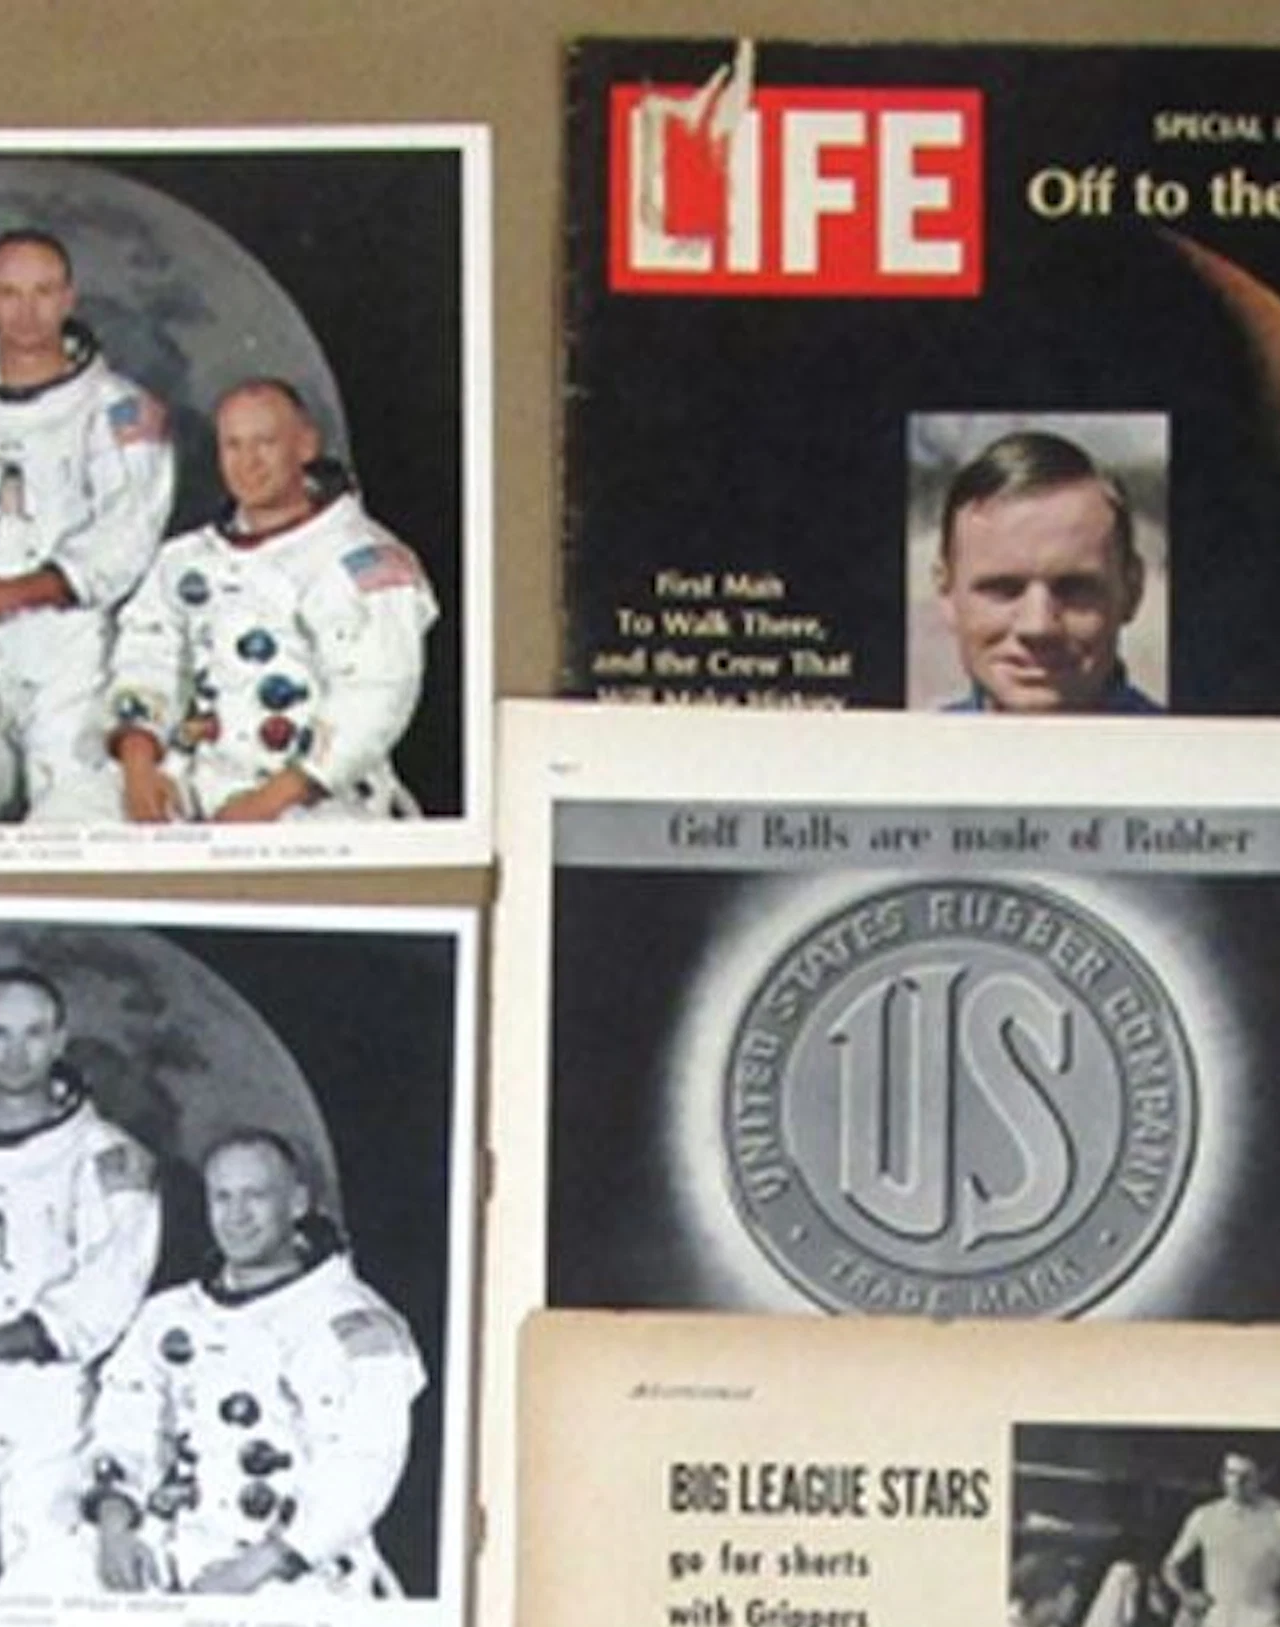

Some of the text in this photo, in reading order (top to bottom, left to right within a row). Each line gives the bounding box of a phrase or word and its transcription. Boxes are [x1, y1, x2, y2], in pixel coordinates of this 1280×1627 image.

[1154, 111, 1263, 143] SPECIAL
[629, 107, 964, 274] LIFE
[1028, 167, 1114, 218] Off
[1134, 174, 1188, 218] to
[655, 572, 786, 598] First Man
[617, 610, 654, 636] To
[662, 610, 730, 637] Walk
[593, 649, 853, 676] and the Crew That
[667, 815, 1255, 856] Golf Balls are made of Rubber
[734, 892, 1178, 1216] UNITED STATES RUBBER COMPANY
[825, 960, 1077, 1252] US
[827, 1252, 1080, 1313] TRADE MARK
[668, 1462, 991, 1520] BIG LEAGUE STARS
[668, 1544, 870, 1581] go for shorts
